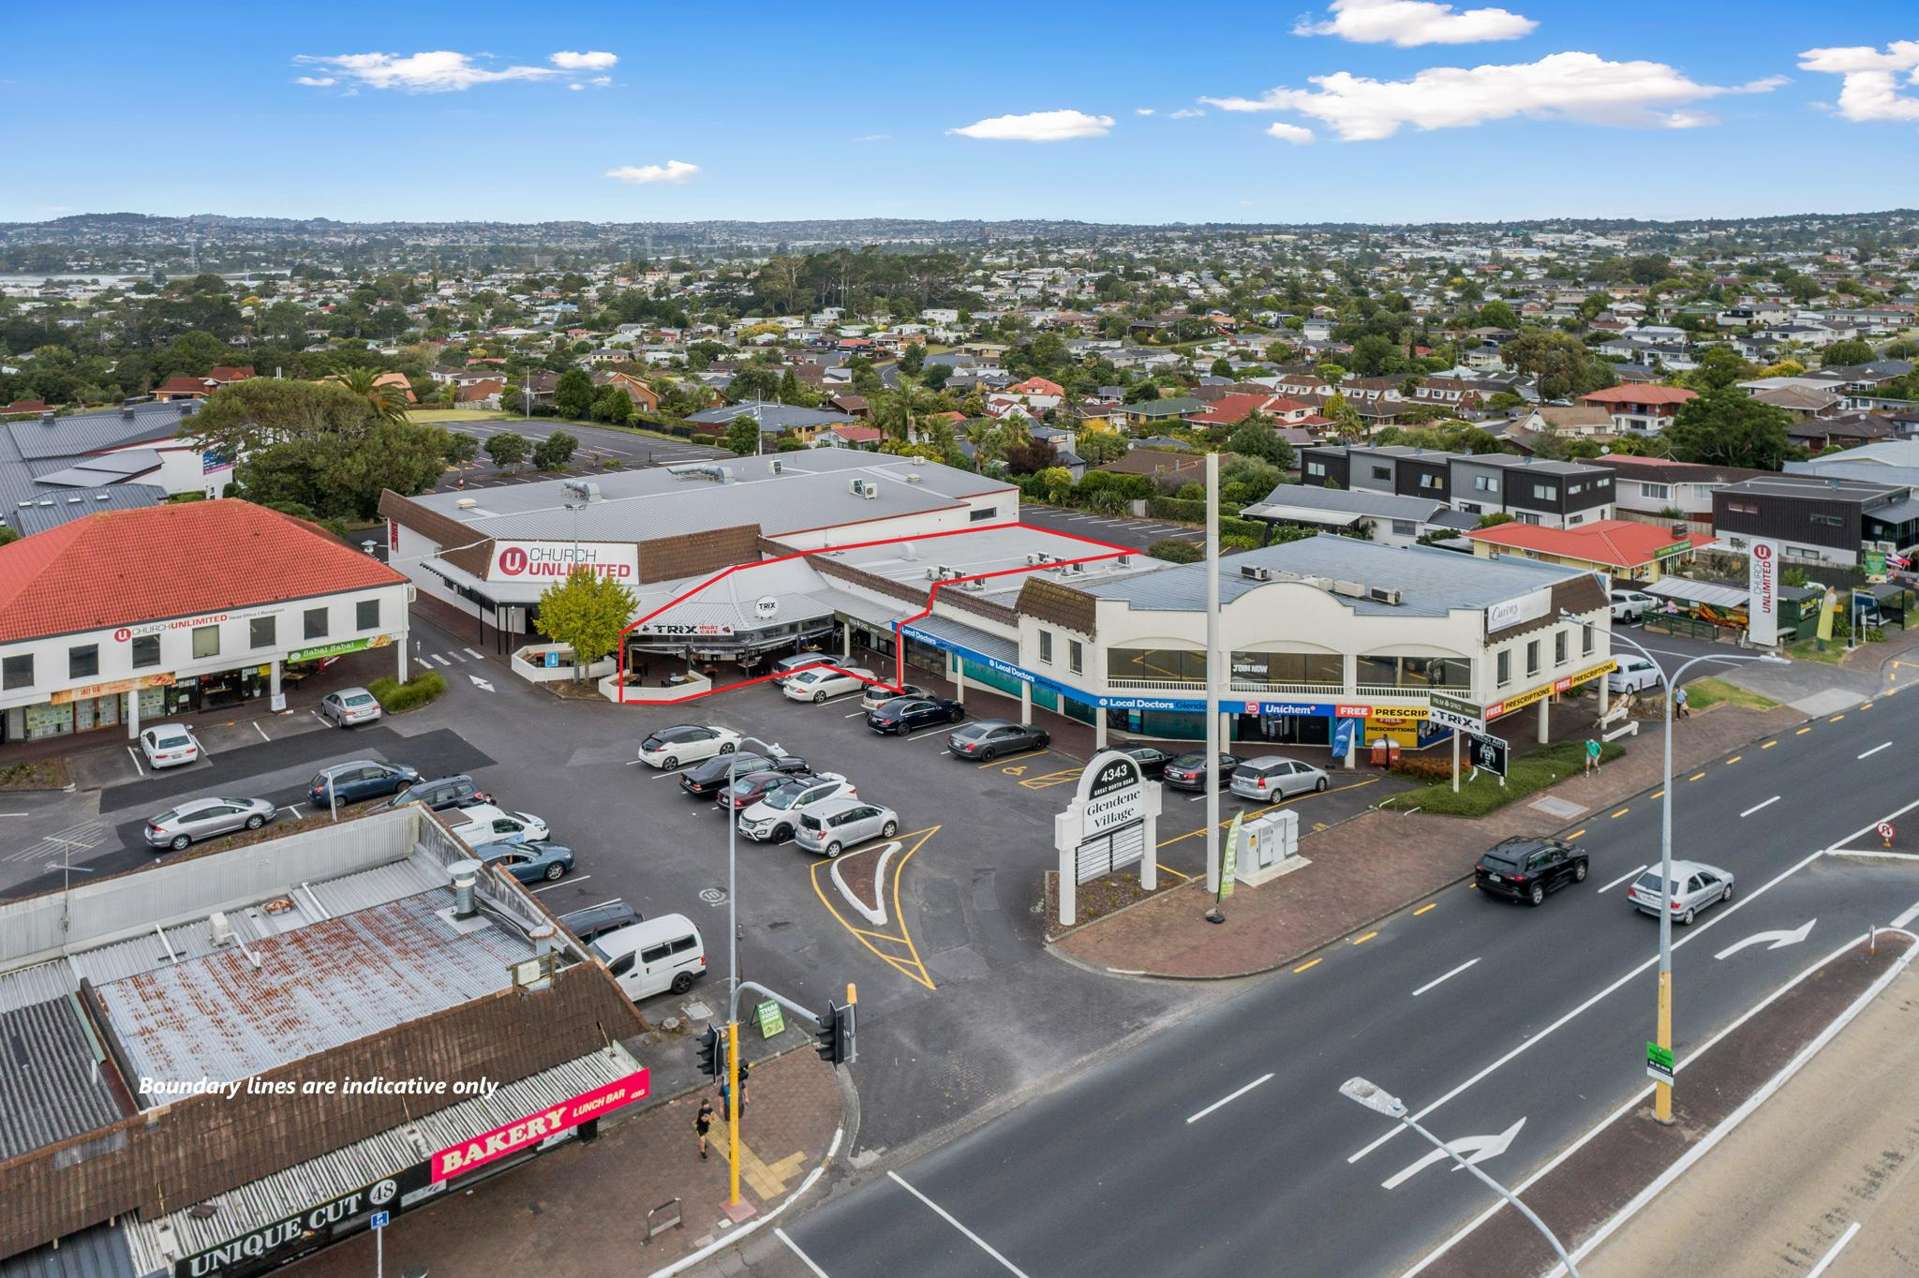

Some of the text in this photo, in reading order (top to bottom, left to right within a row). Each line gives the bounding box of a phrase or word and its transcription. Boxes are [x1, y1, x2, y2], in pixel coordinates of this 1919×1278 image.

[529, 547, 597, 562] CHURCH
[528, 562, 631, 577] UNLIMITED
[1762, 560, 1772, 614] UNLIMITED
[758, 602, 776, 610] TRIX
[653, 625, 698, 634] TRIX
[995, 661, 1011, 673] Local
[1012, 668, 1035, 682] Doctors
[1573, 663, 1614, 683] PRESCRIPTIONS
[1110, 699, 1135, 708] Local
[1137, 699, 1174, 709] Doctors
[1505, 687, 1551, 709] PRESCRIPTIONS
[1265, 704, 1311, 714] Unichem
[1340, 707, 1428, 717] FREE PRESCRIP
[1437, 710, 1473, 728] TRIX
[1101, 764, 1127, 783] 4343
[1094, 777, 1134, 796] GREAT NORTH ROAD
[1087, 790, 1141, 816] Glendene
[1094, 808, 1135, 828] Village
[441, 1107, 567, 1175] BAKERY
[573, 1098, 605, 1118] LUNCH
[606, 1088, 626, 1105] BAR
[190, 1216, 302, 1278] UNIQUE
[309, 1193, 362, 1230] CUT
